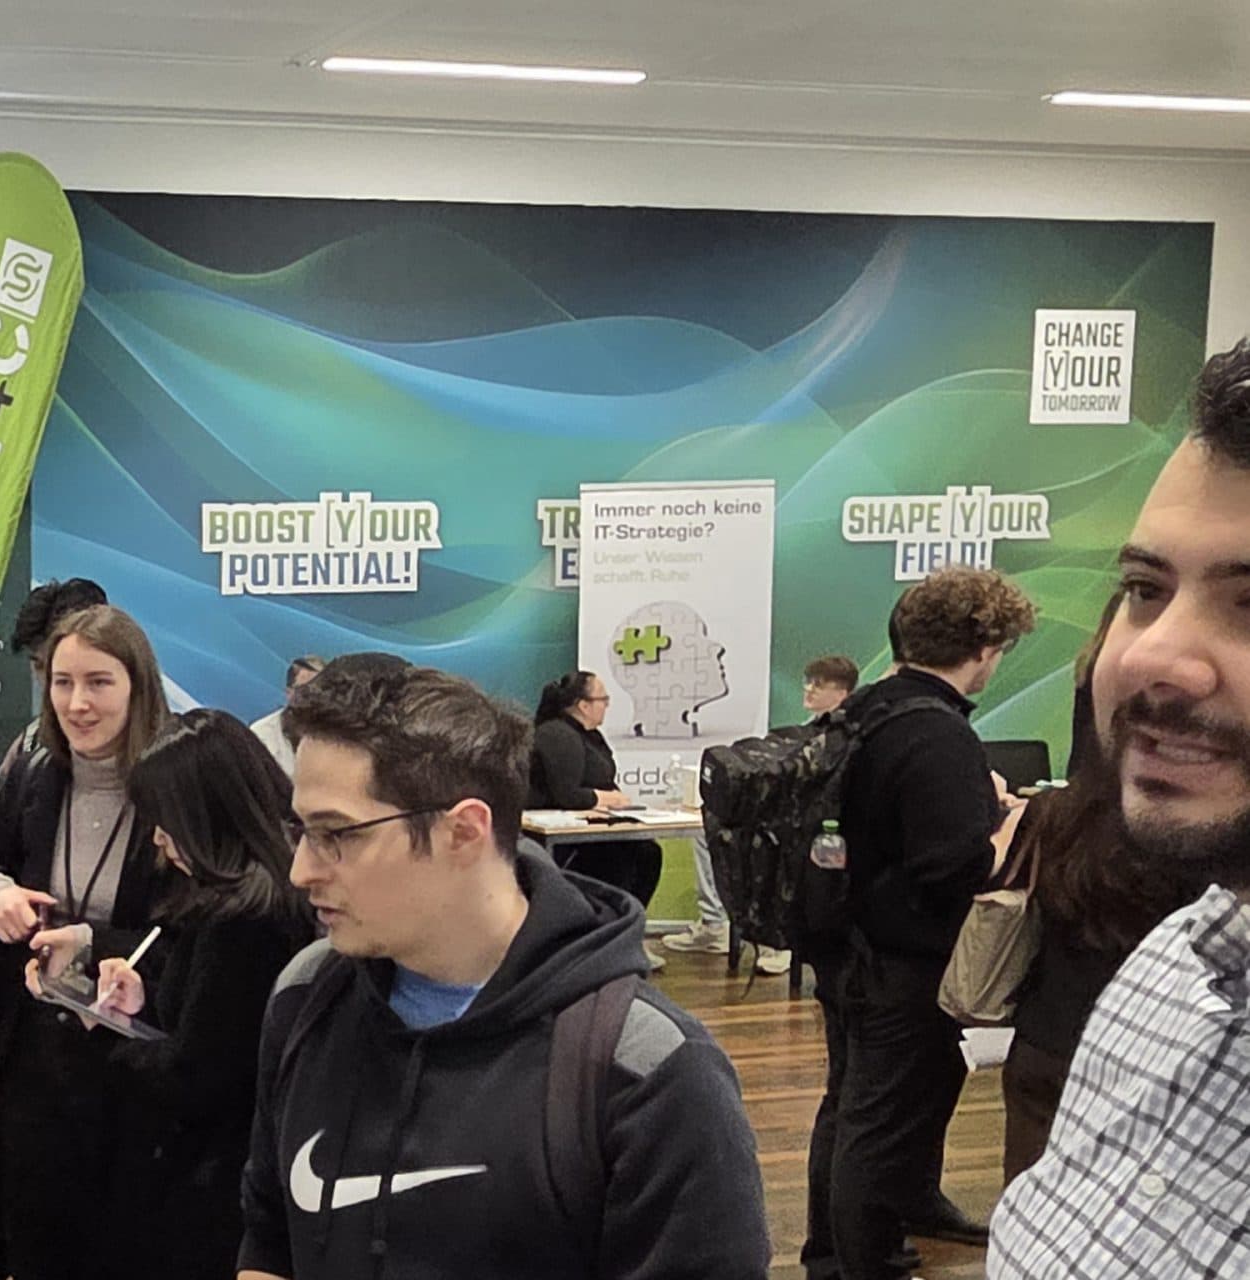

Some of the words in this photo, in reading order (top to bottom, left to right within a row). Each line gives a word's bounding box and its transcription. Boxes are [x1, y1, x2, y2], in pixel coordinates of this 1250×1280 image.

[1044, 321, 1125, 348] CHANGE
[1042, 349, 1122, 391] [Y]OUR
[1041, 394, 1122, 412] TOMORROW
[593, 502, 656, 519] Immer
[661, 499, 707, 517] noch
[713, 498, 763, 516] keine
[848, 502, 943, 535] SHAPE
[950, 492, 1043, 539] [Y]OUR
[208, 509, 316, 545] BOOST
[326, 499, 433, 549] [Y]OUR
[593, 521, 716, 543] IT-Strategie?
[228, 551, 412, 588] POTENTIAL!
[593, 551, 639, 566] Unser
